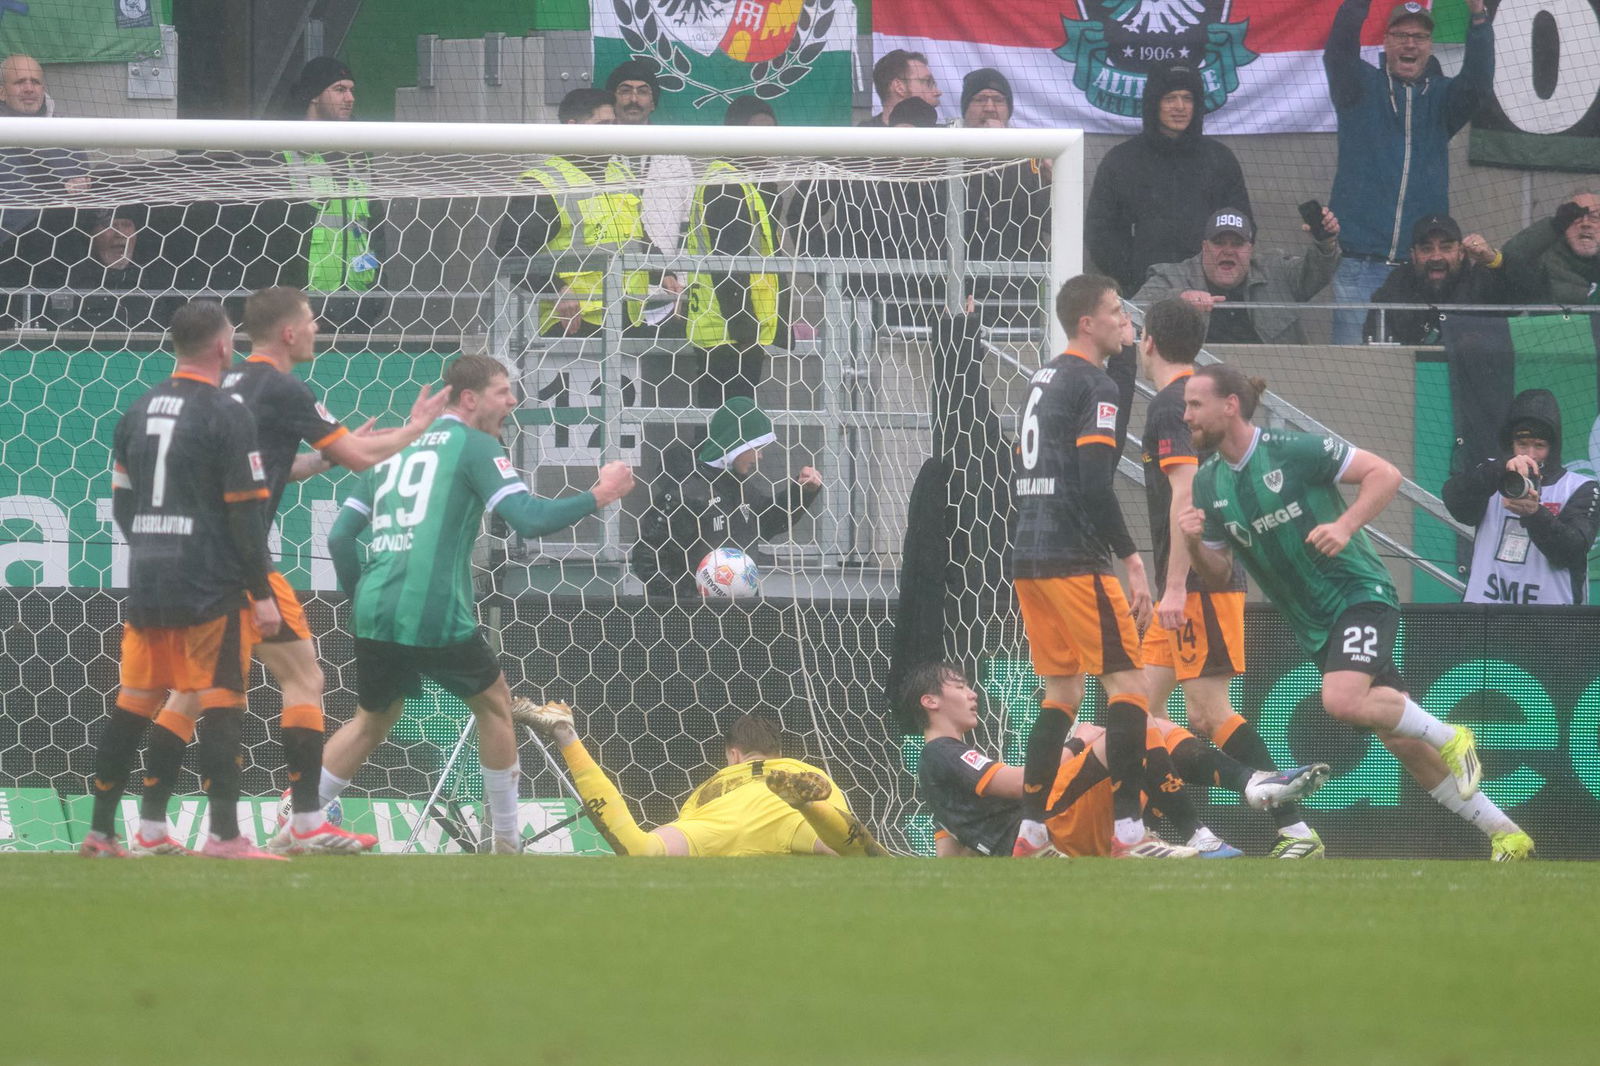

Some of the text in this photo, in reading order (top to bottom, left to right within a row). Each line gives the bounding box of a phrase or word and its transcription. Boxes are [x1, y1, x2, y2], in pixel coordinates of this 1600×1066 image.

[1139, 46, 1175, 61] 1906
[1215, 214, 1243, 228] 1906
[1021, 386, 1043, 470] 6
[146, 417, 176, 507] 7
[372, 450, 439, 533] 29
[1252, 501, 1303, 534] FIEGE
[1342, 625, 1378, 657] 22
[1350, 653, 1371, 664] JAKO
